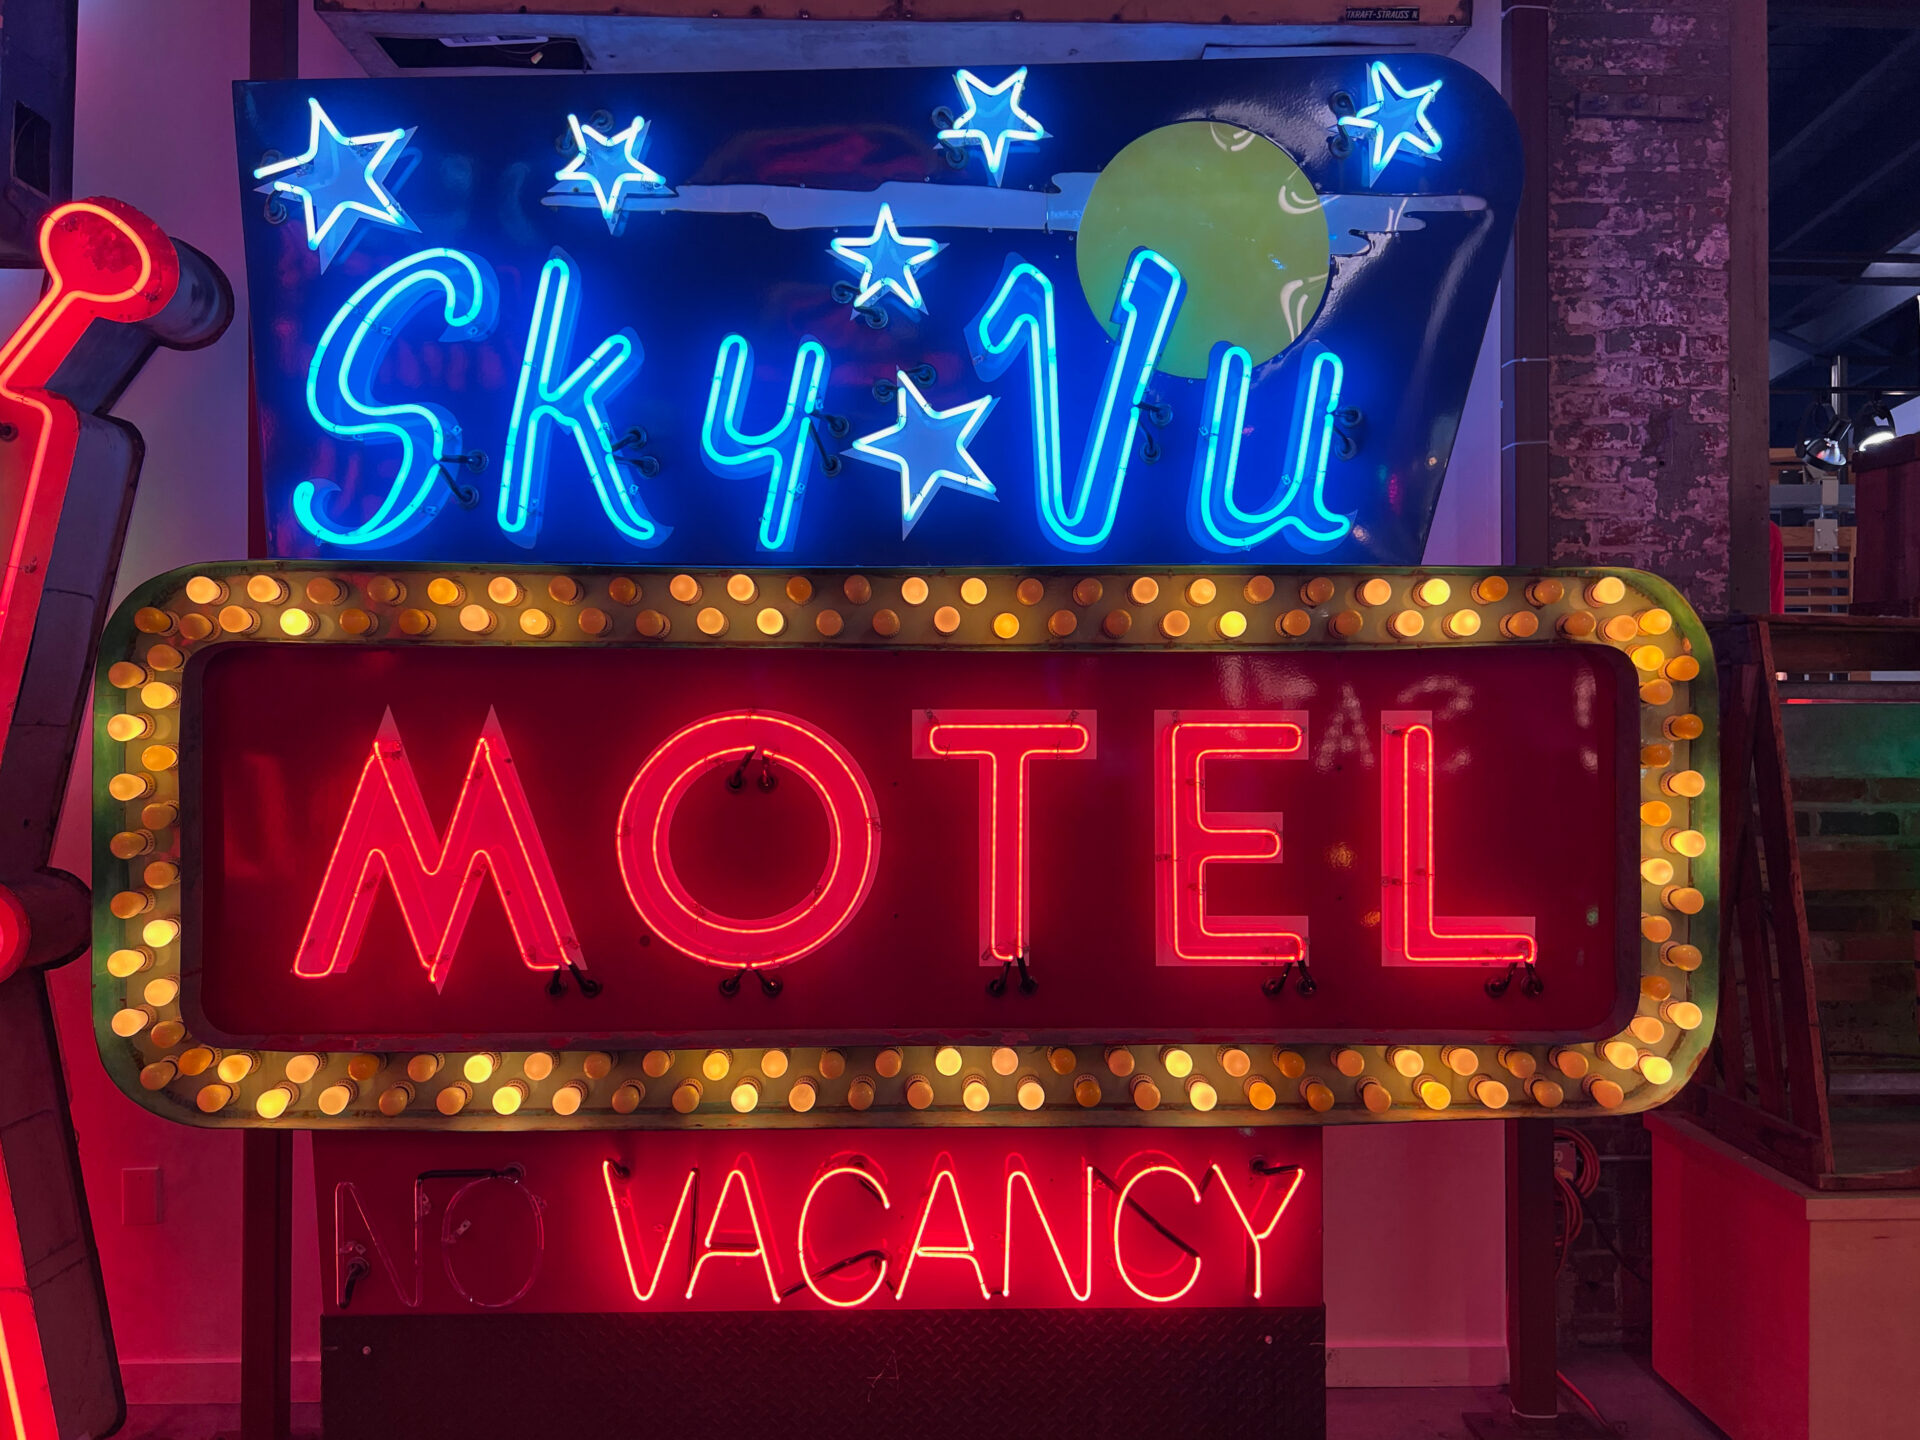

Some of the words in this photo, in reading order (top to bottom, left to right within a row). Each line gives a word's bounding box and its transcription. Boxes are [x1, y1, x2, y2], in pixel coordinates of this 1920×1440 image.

[293, 246, 828, 552] Sky
[968, 246, 1355, 552] Vu
[291, 705, 1536, 993] MOTEL
[335, 1174, 545, 1308] NO
[602, 1151, 1306, 1307] VACANCY
